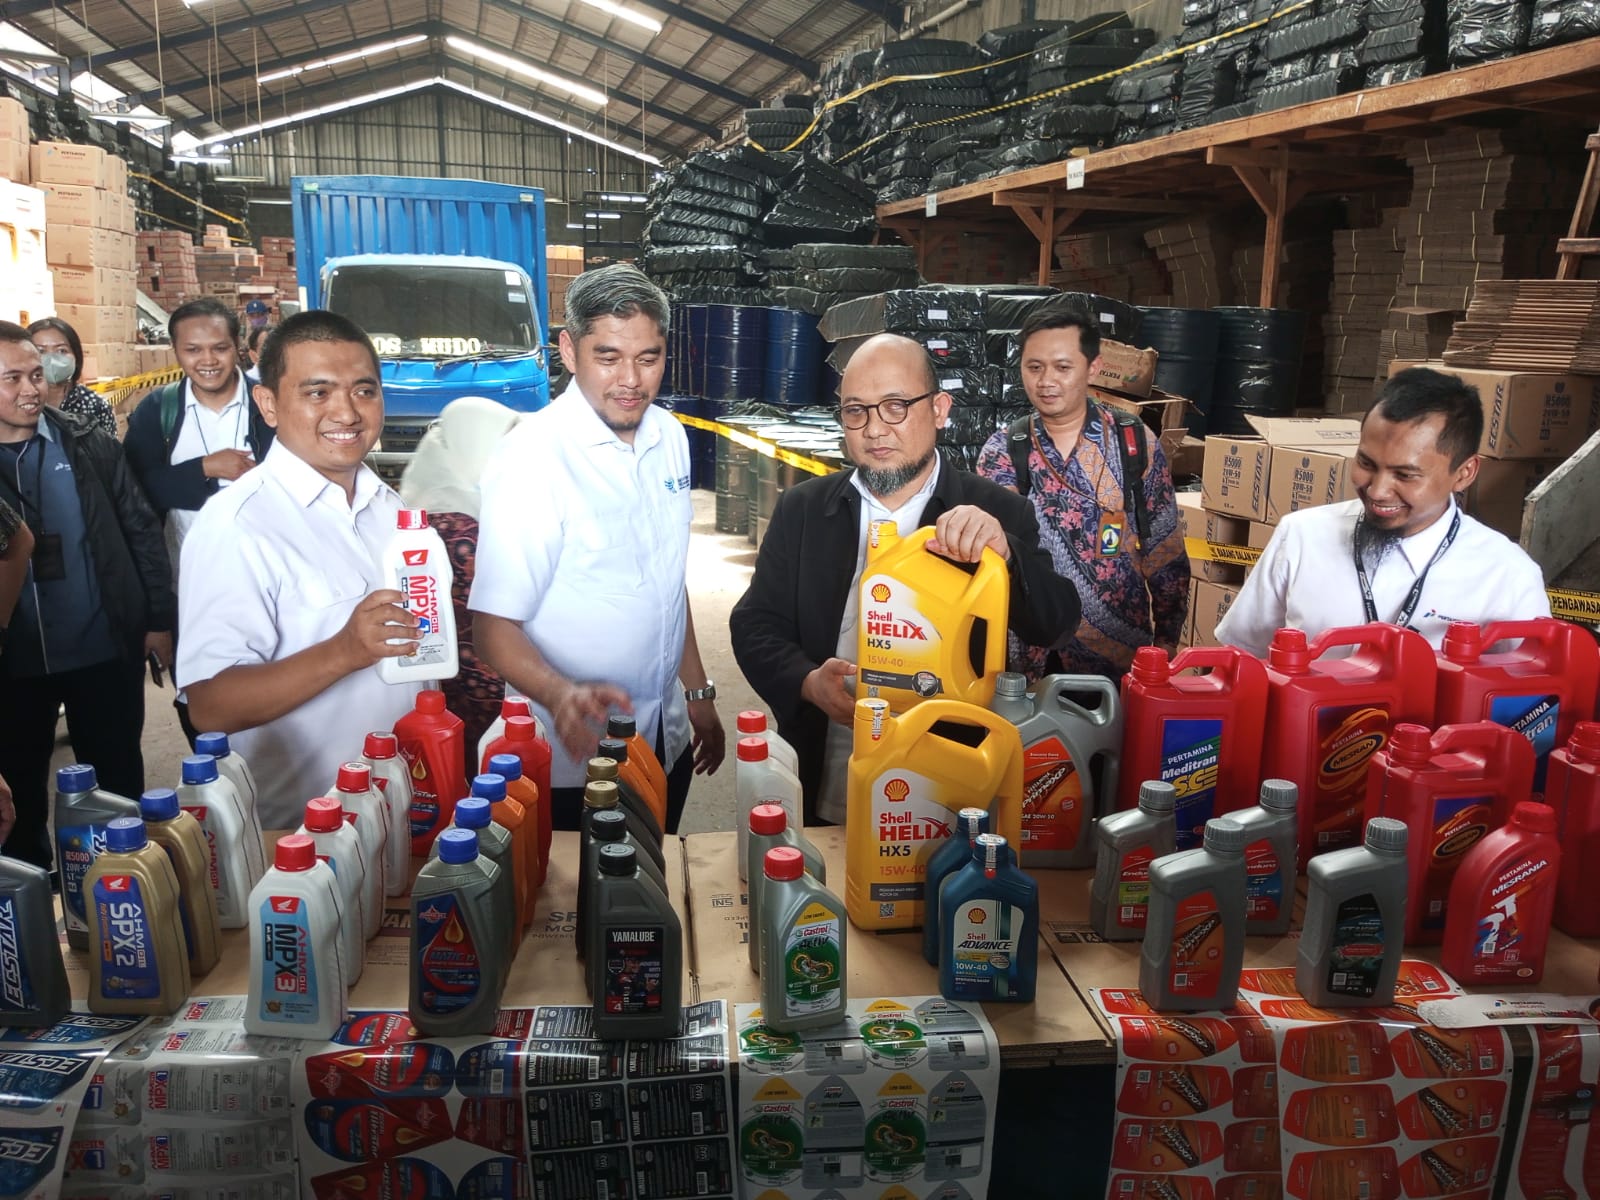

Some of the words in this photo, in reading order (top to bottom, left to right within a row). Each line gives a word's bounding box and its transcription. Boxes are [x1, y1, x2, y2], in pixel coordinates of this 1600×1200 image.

[1099, 370, 1121, 380] PERTA
[1489, 384, 1504, 449] ECSTAR
[1224, 456, 1242, 469] R5000
[1222, 469, 1241, 478] 20W-50
[1294, 469, 1314, 482] R5000
[1252, 451, 1264, 513] ECSTAR
[1292, 482, 1313, 493] 20W-50
[867, 610, 892, 622] Shell
[867, 620, 926, 640] HELIX
[867, 638, 892, 650] HX5
[868, 654, 904, 668] 15W-40
[1332, 729, 1364, 750] PERTAMINA
[1168, 744, 1214, 765] PERTAMINA
[1333, 741, 1374, 767] MESRAN
[1162, 754, 1217, 780] Meditran
[880, 812, 912, 824] Shell
[879, 823, 951, 842] HELIX
[1444, 821, 1471, 837] PERTAMINA
[880, 845, 911, 856] HX5
[880, 864, 925, 876] 15W-40
[1498, 860, 1532, 882] PERTAMINA
[1492, 860, 1548, 896] MESRANIA
[612, 931, 656, 942] YAMALUBE
[804, 926, 828, 936] Castrol
[958, 940, 1013, 950] ADVANCE
[274, 924, 298, 993] MPX3
[956, 962, 988, 970] 10W-40
[155, 1070, 168, 1109] MPX1
[888, 1100, 915, 1108] Castrol
